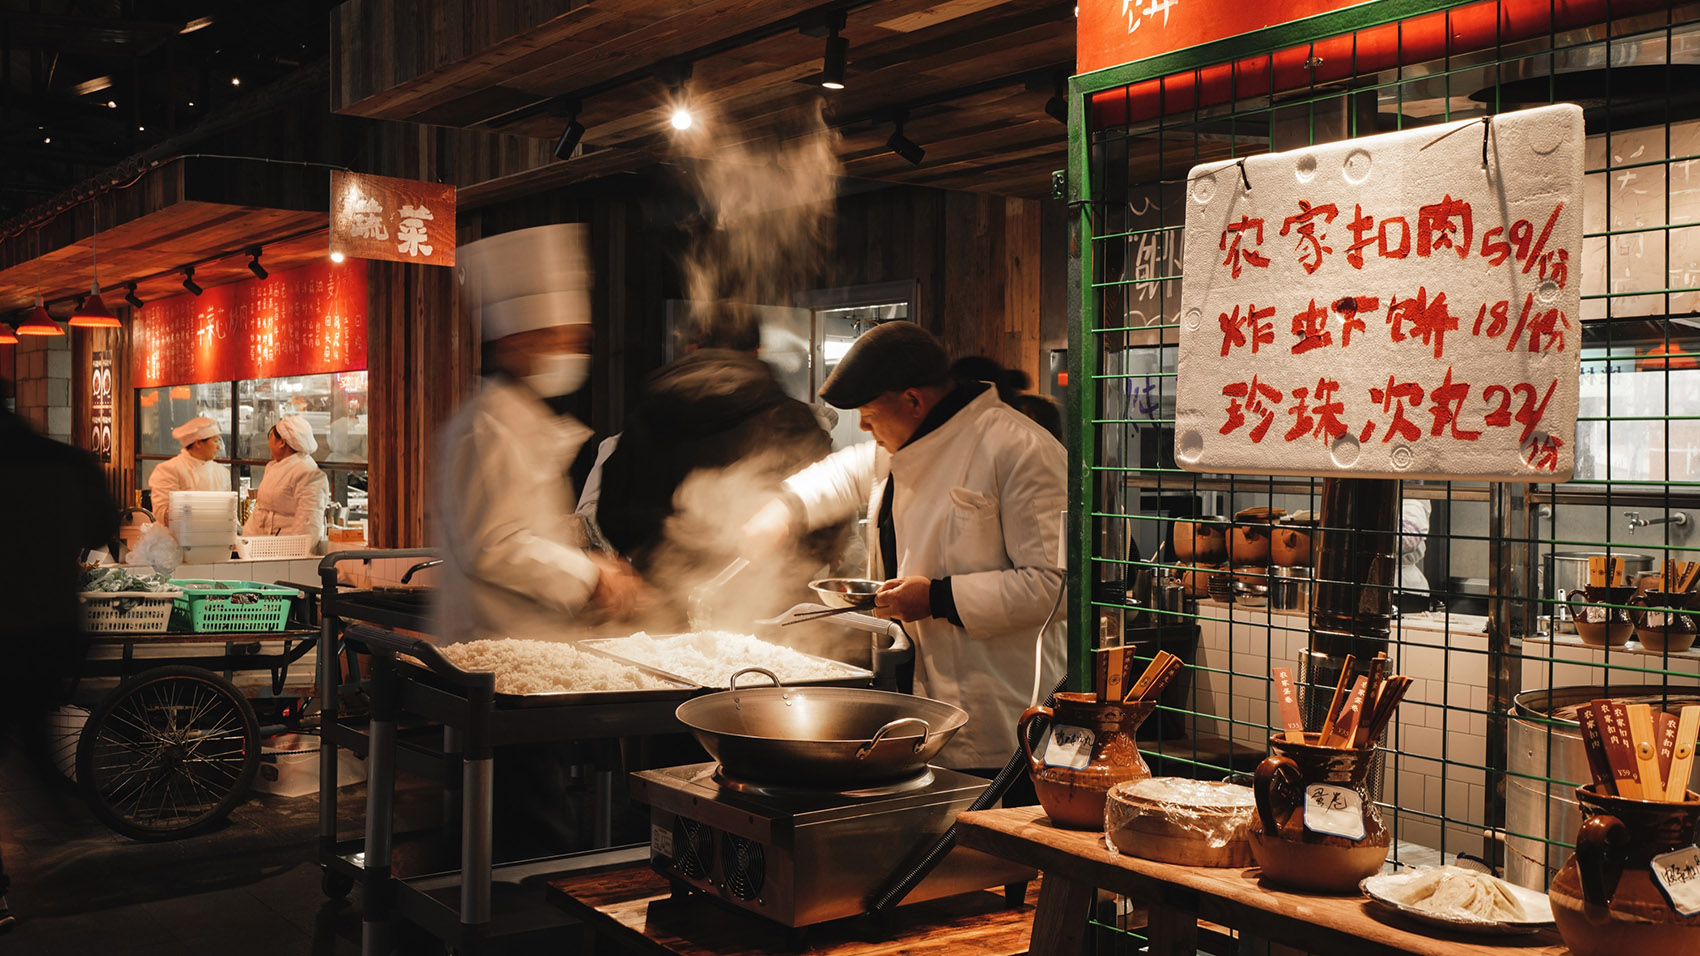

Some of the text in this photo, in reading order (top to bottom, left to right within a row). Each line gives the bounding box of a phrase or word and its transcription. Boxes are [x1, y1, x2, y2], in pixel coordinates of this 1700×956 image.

[345, 198, 434, 257] 蔬菜
[1584, 710, 1601, 750] 农家扣肉
[1600, 704, 1619, 745] 农家扣肉
[1661, 720, 1677, 758] 农家扣肉
[1617, 769, 1631, 777] ¥59
